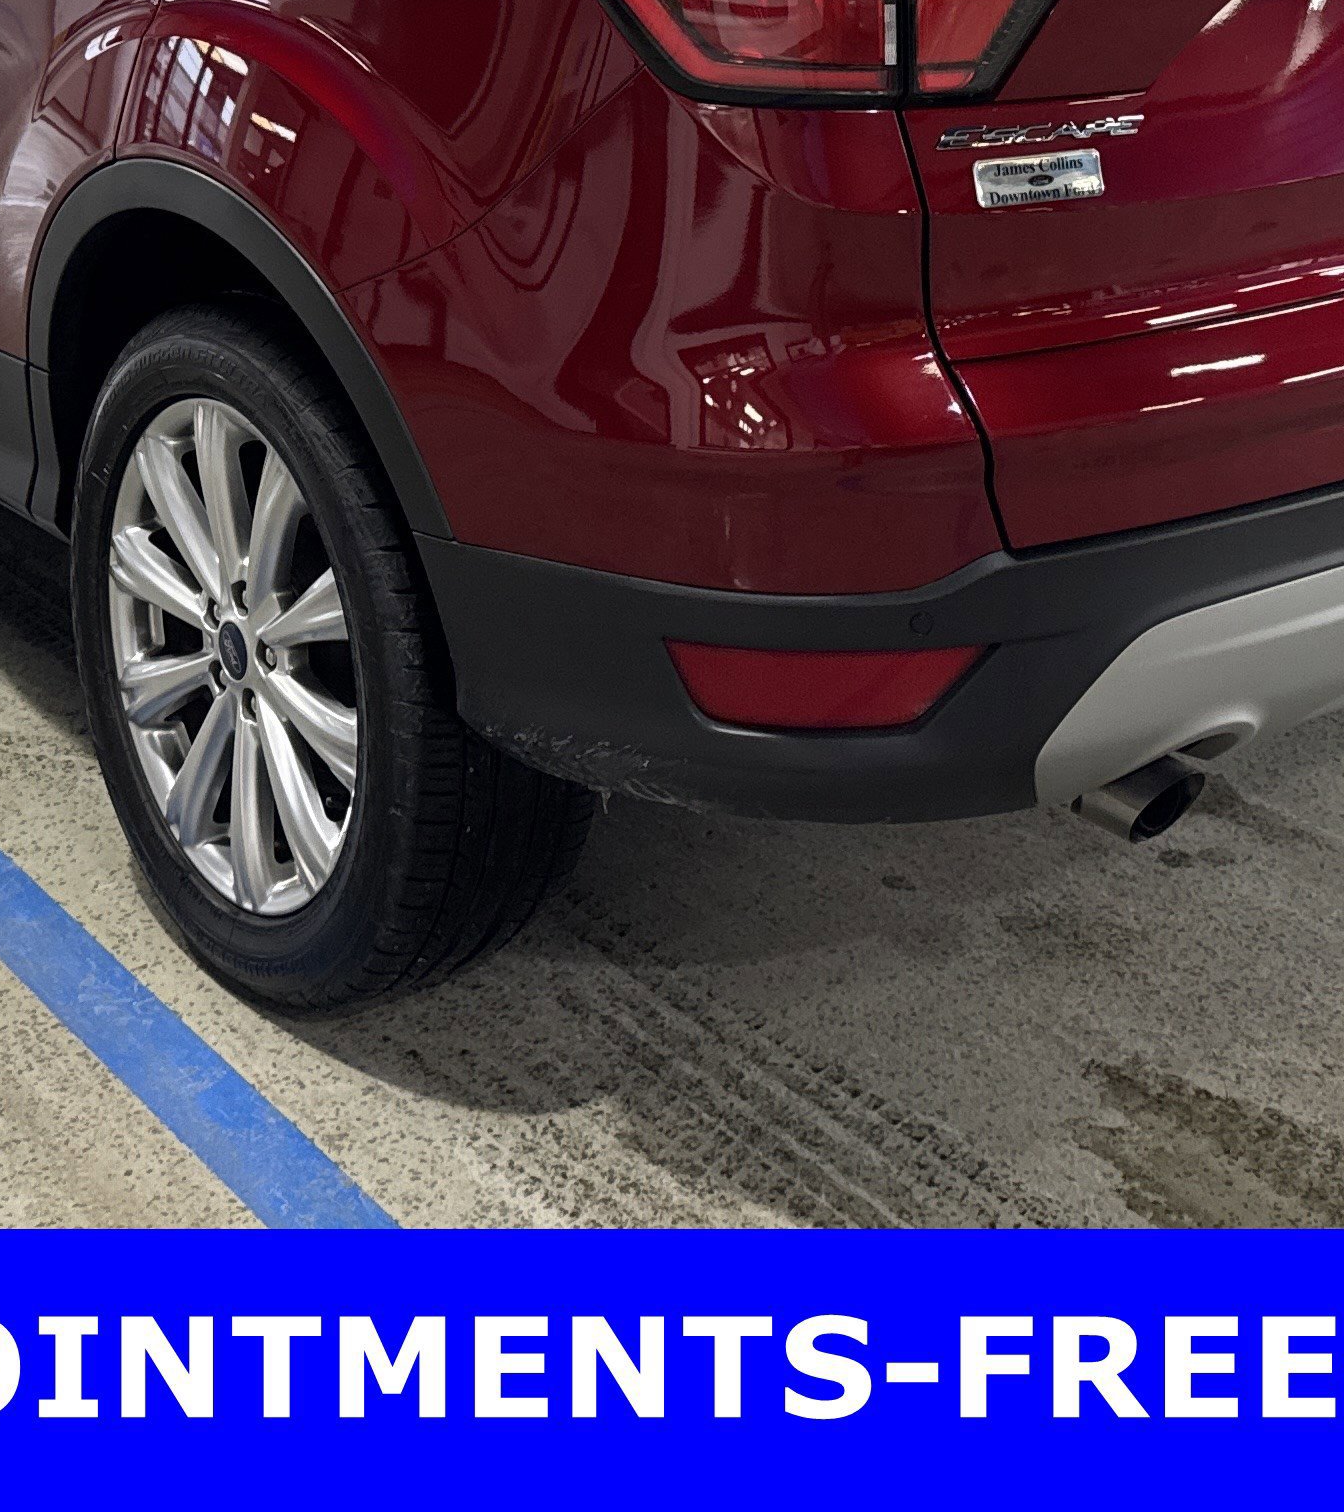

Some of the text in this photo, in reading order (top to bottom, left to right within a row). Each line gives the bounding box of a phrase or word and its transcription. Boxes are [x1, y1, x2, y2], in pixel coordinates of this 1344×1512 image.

[936, 114, 1145, 151] ESCAPE
[993, 157, 1084, 178] James Collins
[989, 187, 1061, 206] Downtown
